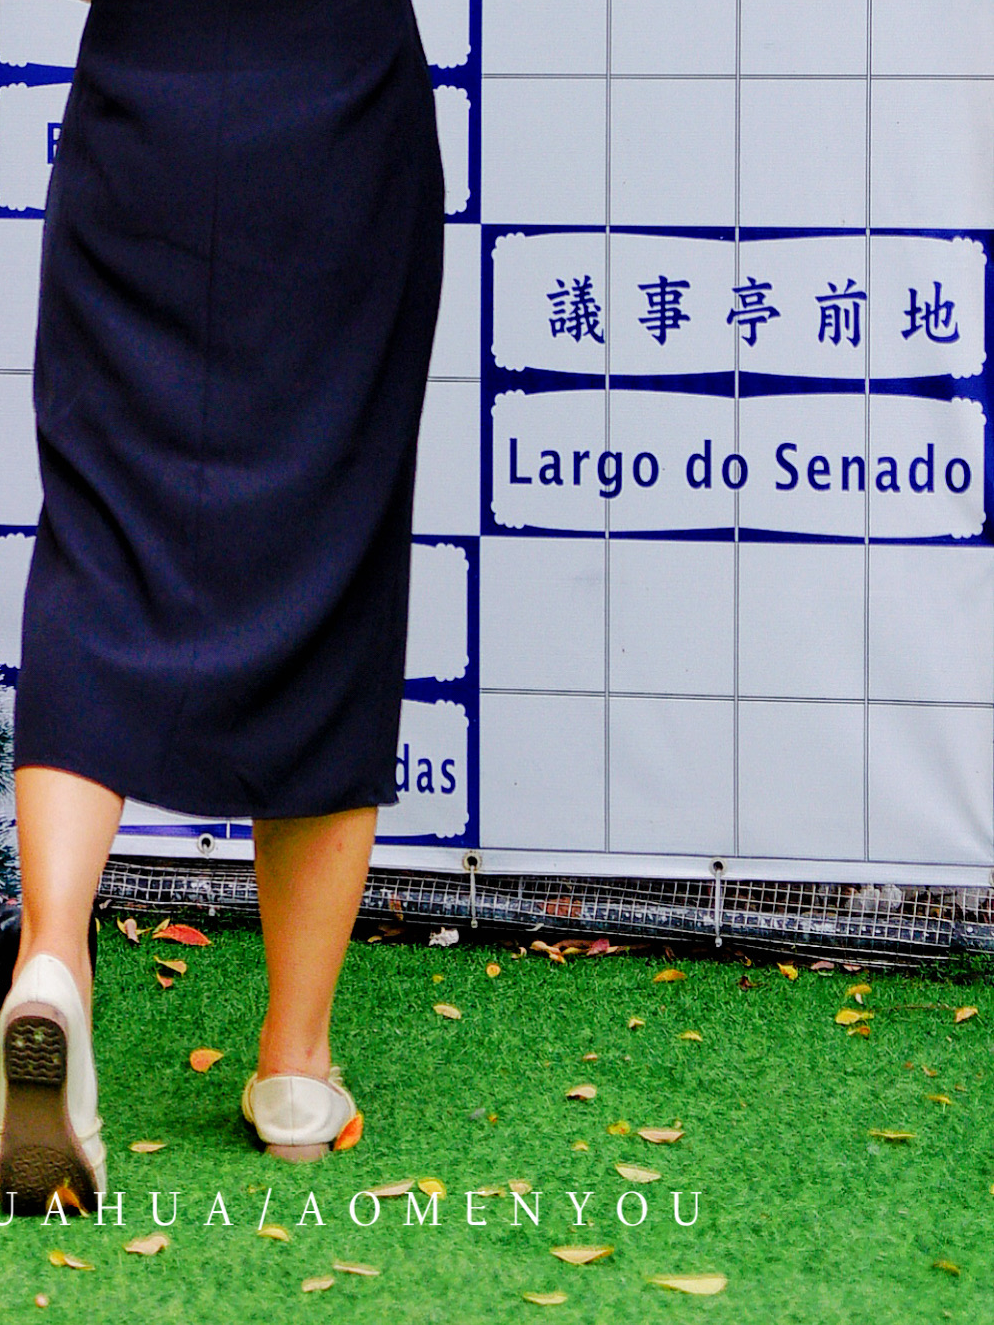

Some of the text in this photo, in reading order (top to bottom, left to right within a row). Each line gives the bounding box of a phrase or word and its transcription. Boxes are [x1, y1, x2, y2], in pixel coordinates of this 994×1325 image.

[546, 274, 961, 348] 議事亭前地
[509, 437, 973, 500] Largo do Senado
